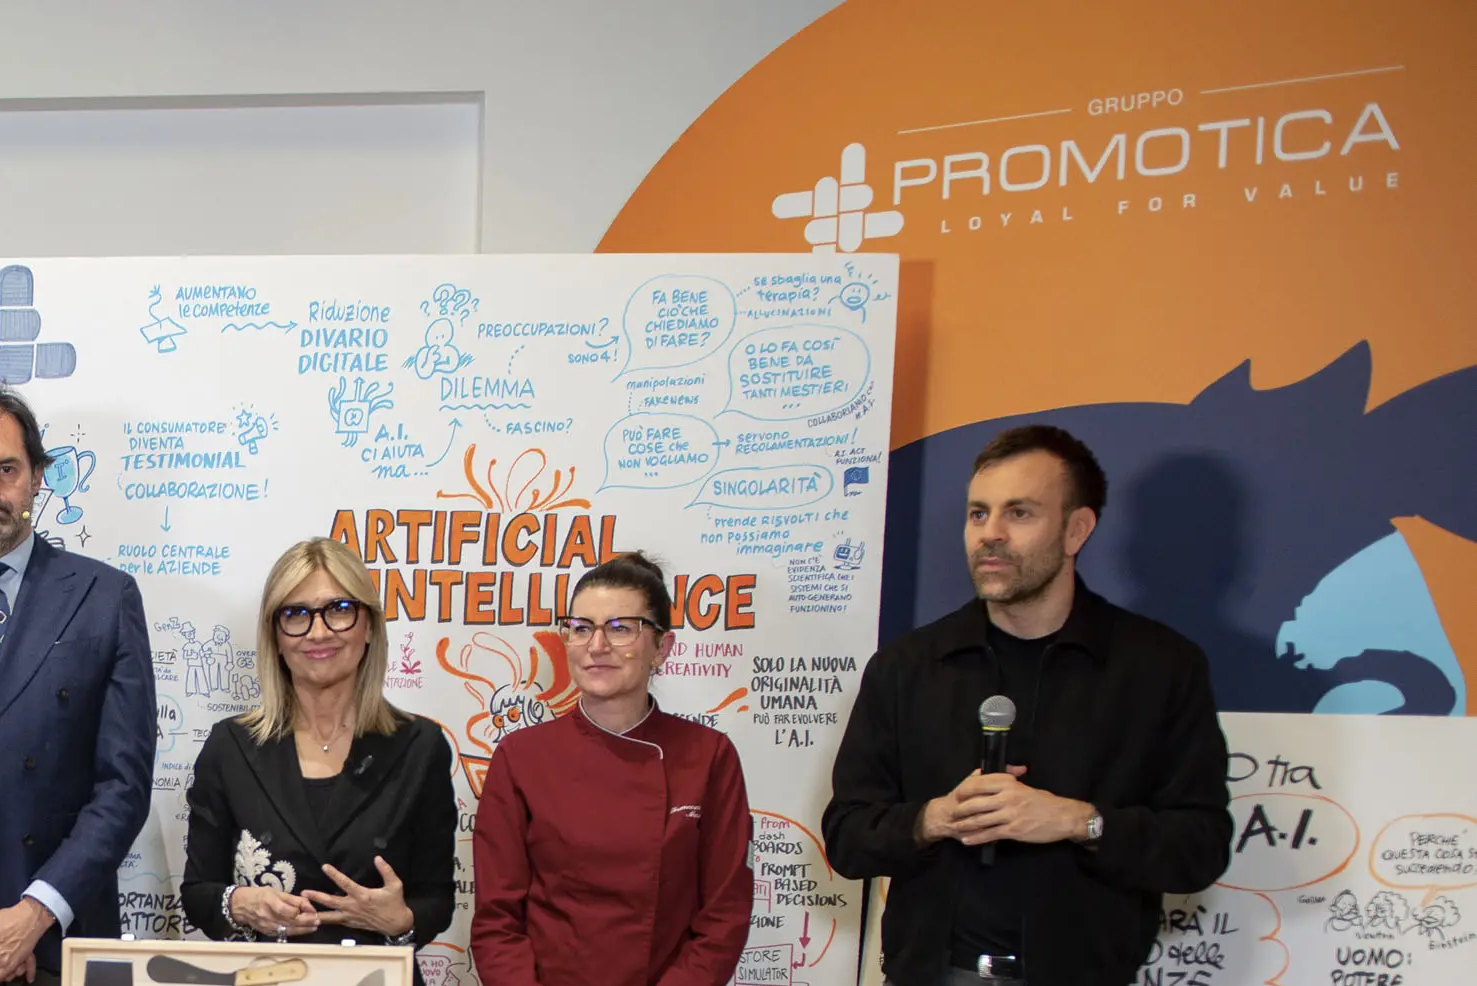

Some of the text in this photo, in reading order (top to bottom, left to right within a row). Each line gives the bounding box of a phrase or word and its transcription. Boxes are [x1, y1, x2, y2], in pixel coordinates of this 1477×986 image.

[1087, 88, 1184, 116] GRUPPO
[893, 102, 1400, 206] PROMOTICA
[941, 172, 1399, 234] LOYAL FOR VALUE
[673, 290, 708, 304] BENE
[308, 300, 391, 323] Riduzione
[477, 317, 609, 338] PREOCCUPAZIONI?
[645, 317, 719, 333] CHIEDIAMO
[300, 327, 389, 349] DIVARIO
[661, 331, 711, 348] FARE?
[298, 353, 389, 375] DIGITALE
[748, 355, 813, 370] BENE DA
[739, 365, 832, 387] SOSTITUIRE
[440, 376, 535, 401] DILEMMA
[780, 382, 849, 397] MESTIERI
[136, 421, 225, 435] CONSUMATORE
[374, 423, 409, 442] A.I.
[506, 417, 573, 435] FASCINO?
[646, 427, 681, 440] FARE
[129, 437, 184, 450] DIVENTA
[628, 442, 664, 454] COSE
[736, 427, 859, 455] REGOLAMENTAZIONI!
[381, 445, 424, 460] AIUTA
[120, 452, 246, 471] TESTIMONIAL
[618, 453, 709, 470] NON VOGLIAMO
[125, 479, 269, 501] COLLABORAZIONE!
[713, 472, 821, 497] SINGOLARITÀ
[761, 512, 819, 526] RISVOLTI
[328, 508, 634, 569] ARTIFICIAL
[118, 544, 230, 560] RUOLO CENTRALE
[736, 540, 824, 558] immaginare
[156, 560, 222, 575] AZIENDE
[787, 565, 827, 573] EVIDENZA
[366, 567, 757, 631] NTELLINCE
[695, 643, 743, 657] HUMAN
[753, 656, 857, 673] SOLO LA NUOVA
[751, 676, 843, 694] ORIGINALITÀ
[760, 695, 818, 711] UMANA
[754, 712, 838, 725] PUÒ FAR EVOLVERE
[761, 817, 790, 829] from
[1235, 804, 1318, 853] A.I.
[759, 831, 785, 841] dash
[761, 863, 811, 877] PROMPT
[774, 878, 817, 893] BASED
[776, 893, 848, 908] DECISIONS
[739, 950, 781, 964] STORE
[738, 966, 788, 982] SIMULATOR
